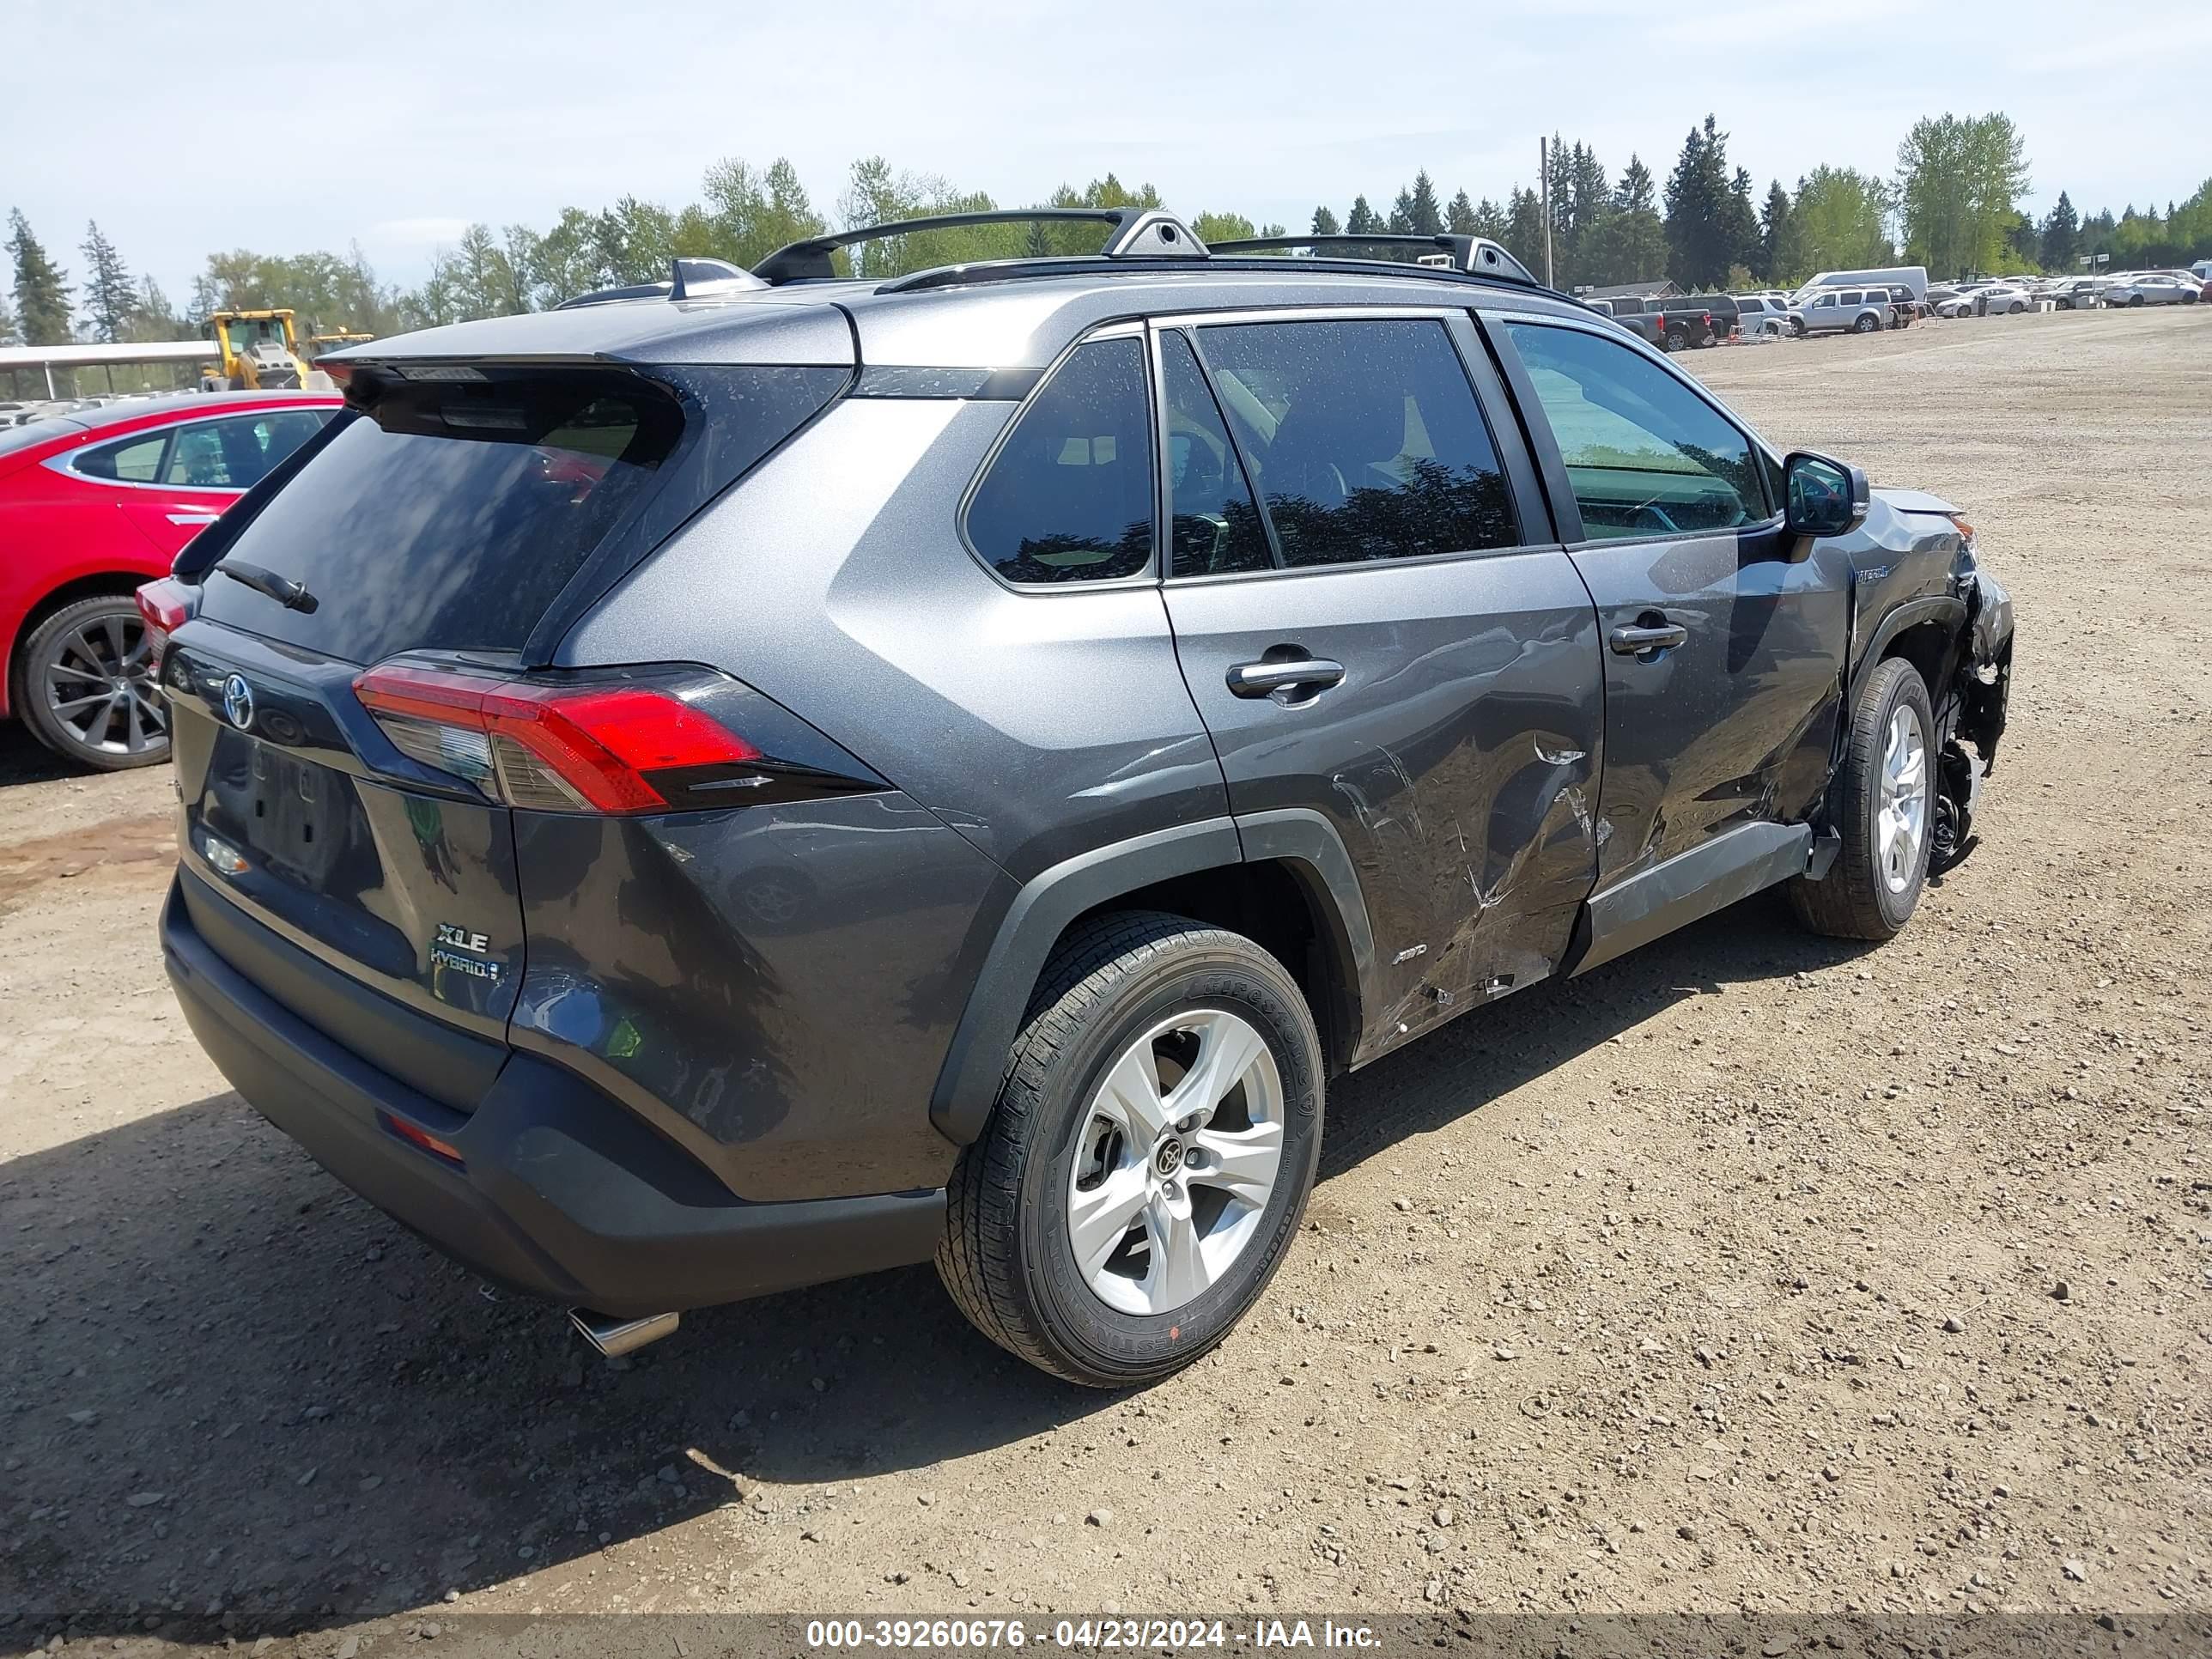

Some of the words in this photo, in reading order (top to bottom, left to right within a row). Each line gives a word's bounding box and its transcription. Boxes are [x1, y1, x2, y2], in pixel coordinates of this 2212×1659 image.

[437, 923, 489, 953] XLE
[430, 947, 489, 978] HYBRID
[1202, 974, 1310, 1086] Firestone
